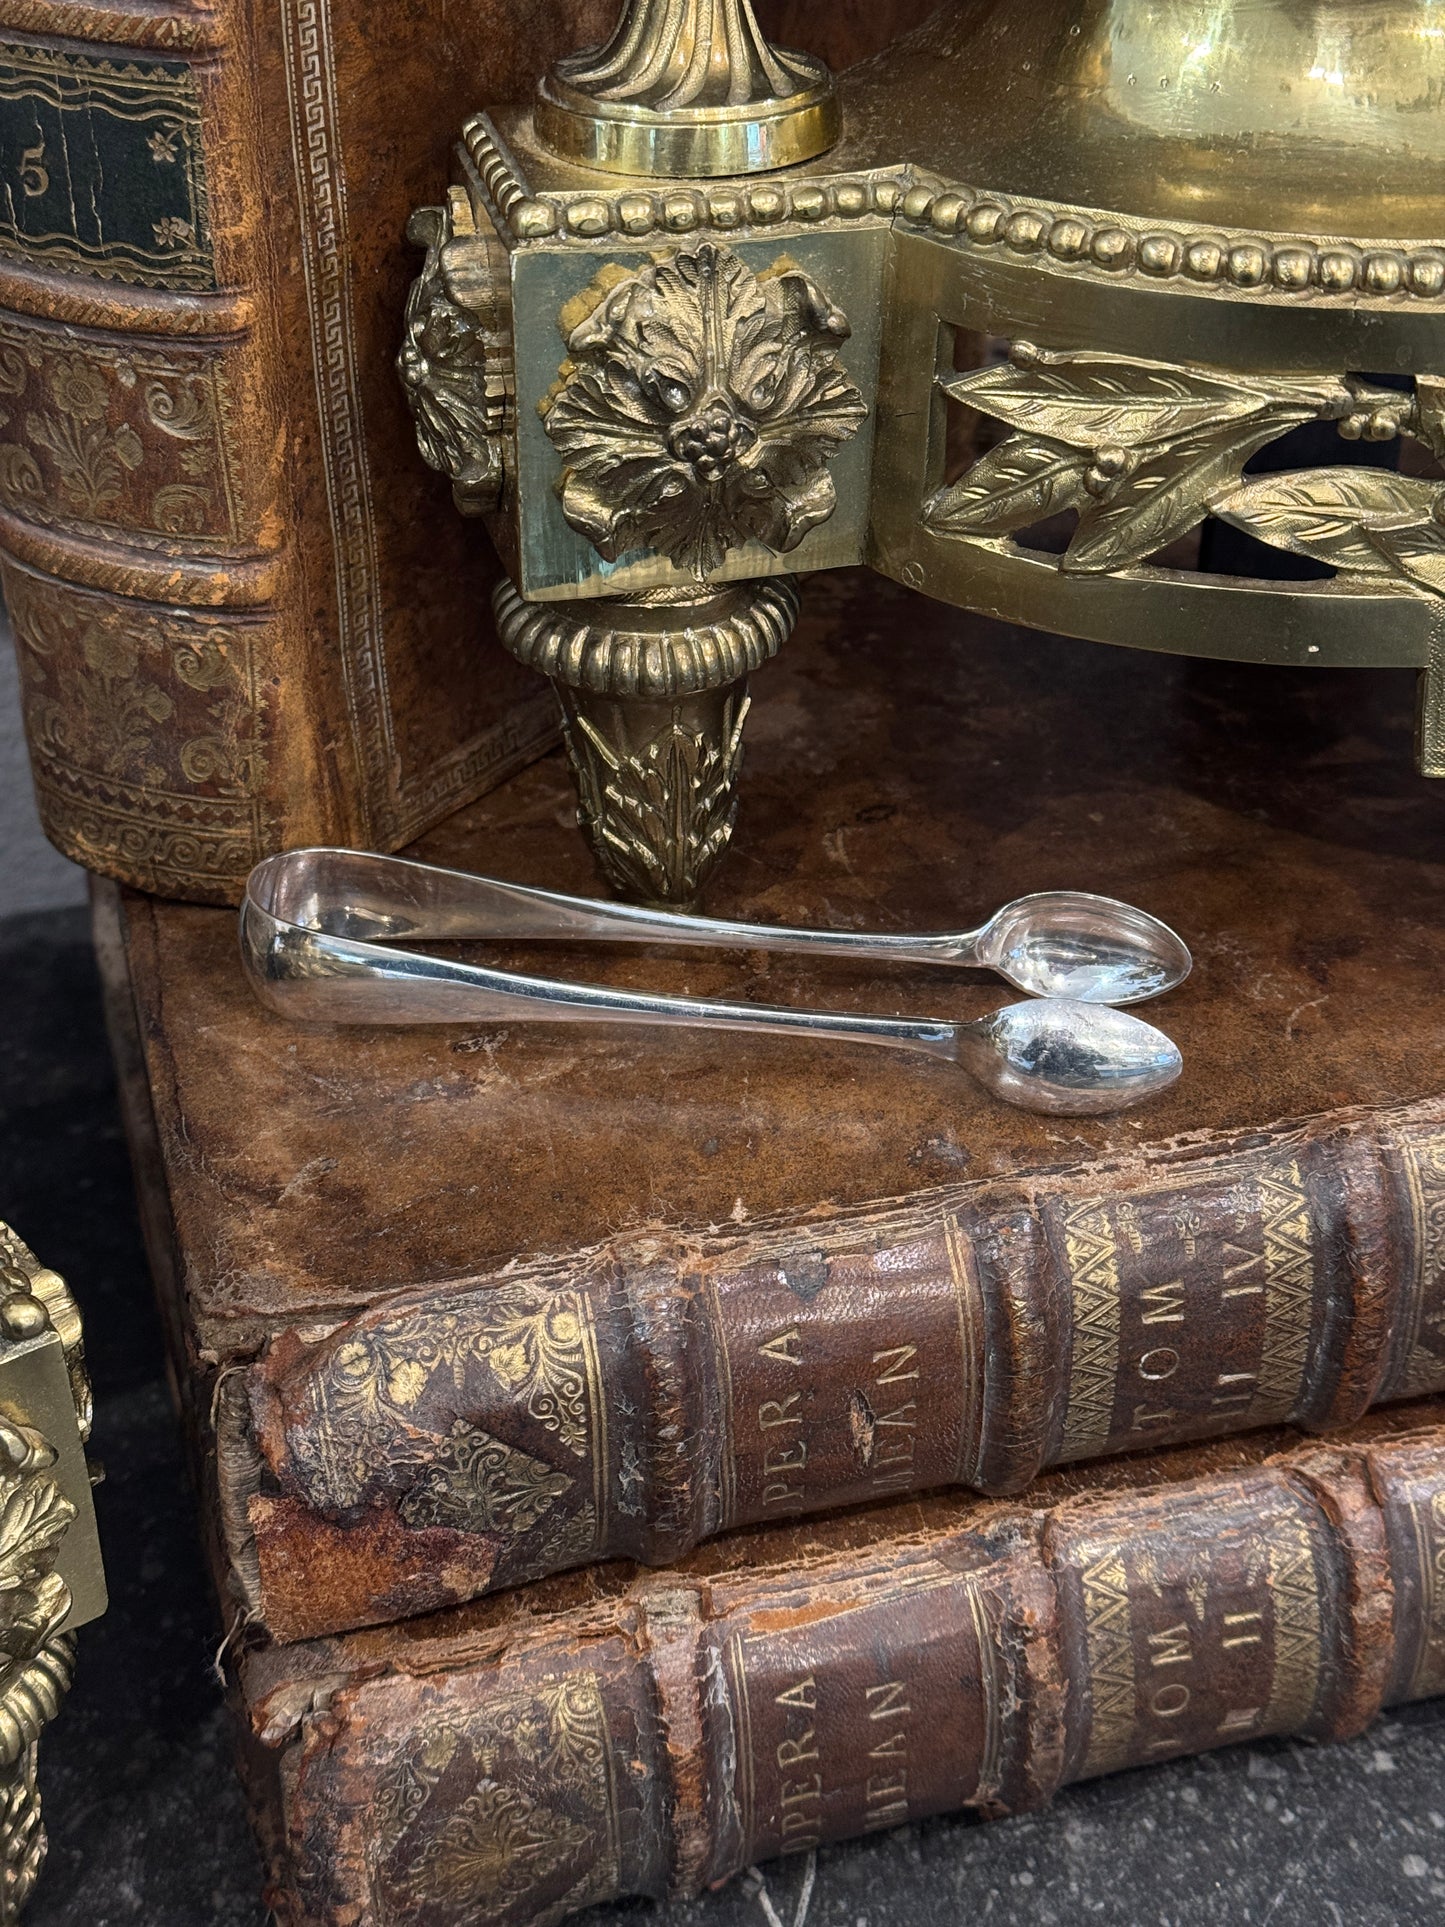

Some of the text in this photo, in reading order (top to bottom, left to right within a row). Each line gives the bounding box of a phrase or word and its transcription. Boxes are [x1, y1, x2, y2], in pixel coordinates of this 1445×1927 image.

[18, 142, 49, 197] 5
[1221, 1241, 1265, 1298] IV
[757, 1323, 807, 1511] PERA
[1132, 1278, 1186, 1431] TOM
[774, 1673, 822, 1850] OPERA
